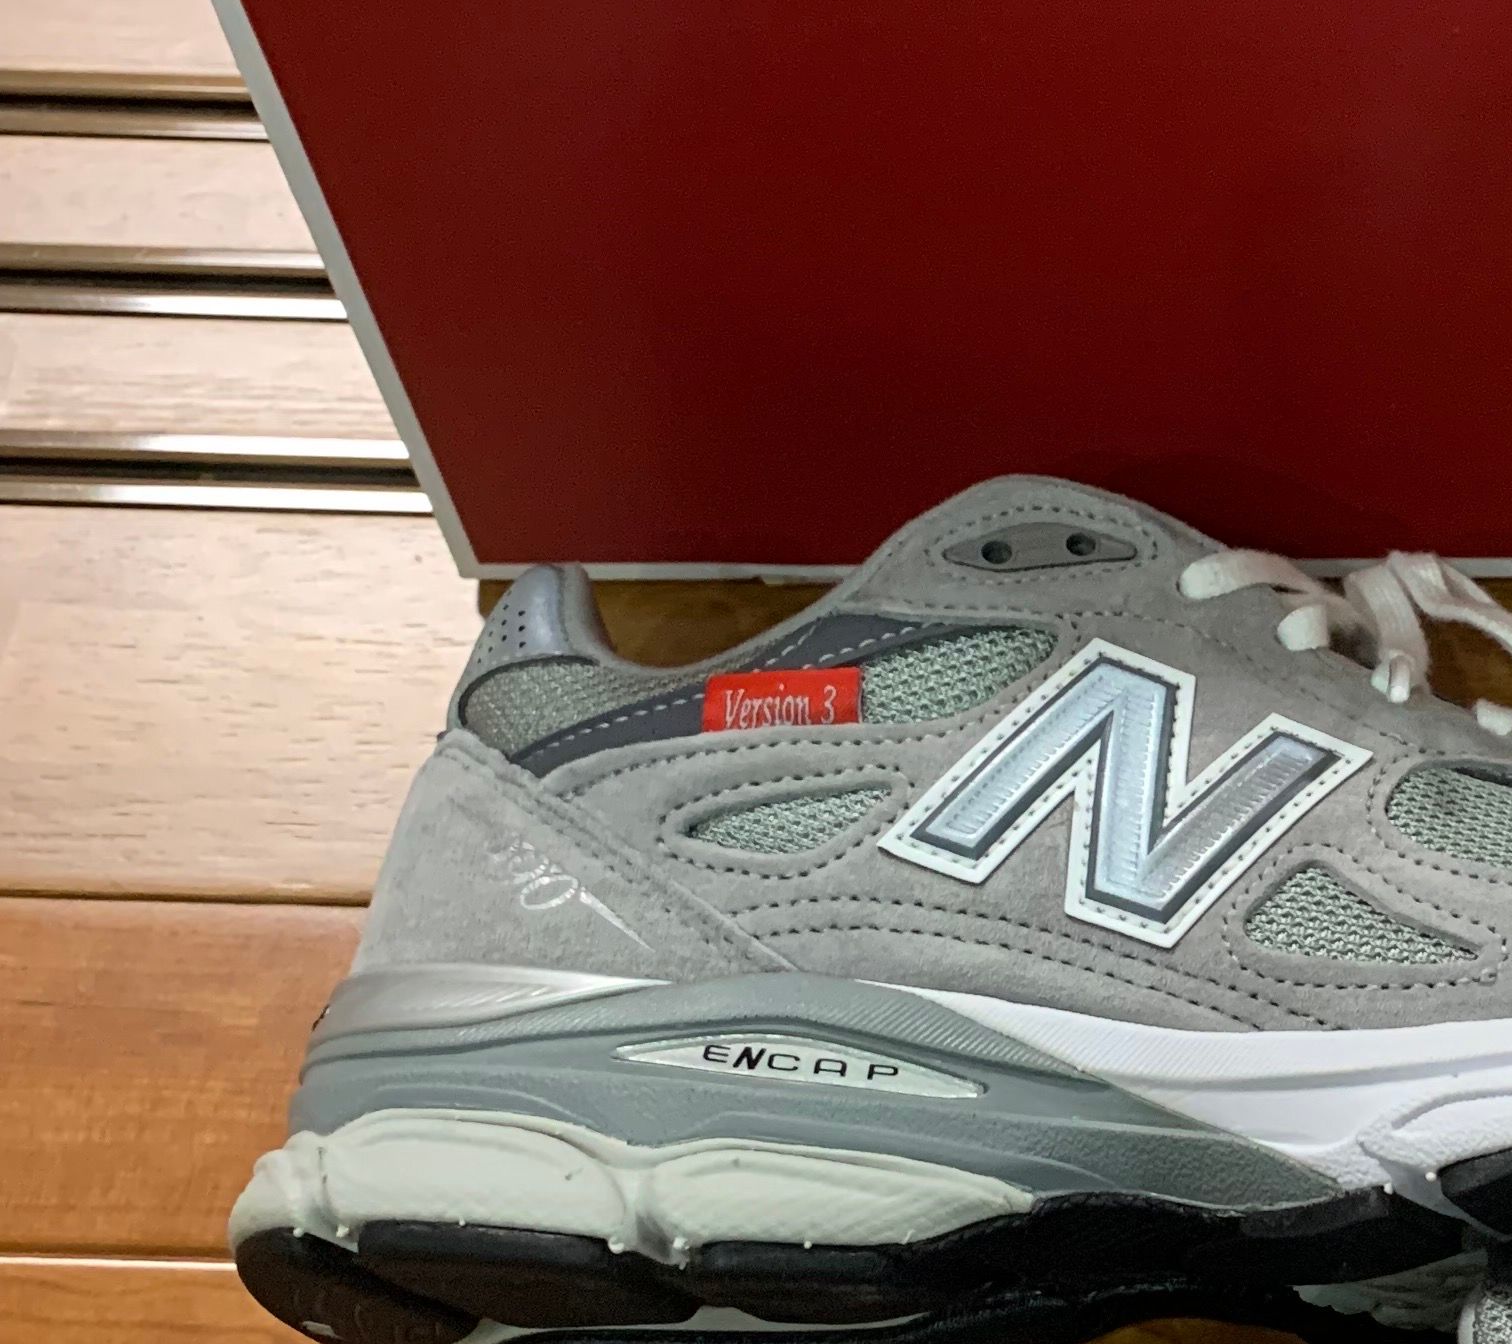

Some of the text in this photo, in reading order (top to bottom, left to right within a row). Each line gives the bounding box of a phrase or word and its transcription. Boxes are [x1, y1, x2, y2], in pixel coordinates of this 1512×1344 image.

[724, 682, 838, 731] Version 3
[876, 637, 1374, 948] N
[702, 1044, 900, 1081] ENCAP
